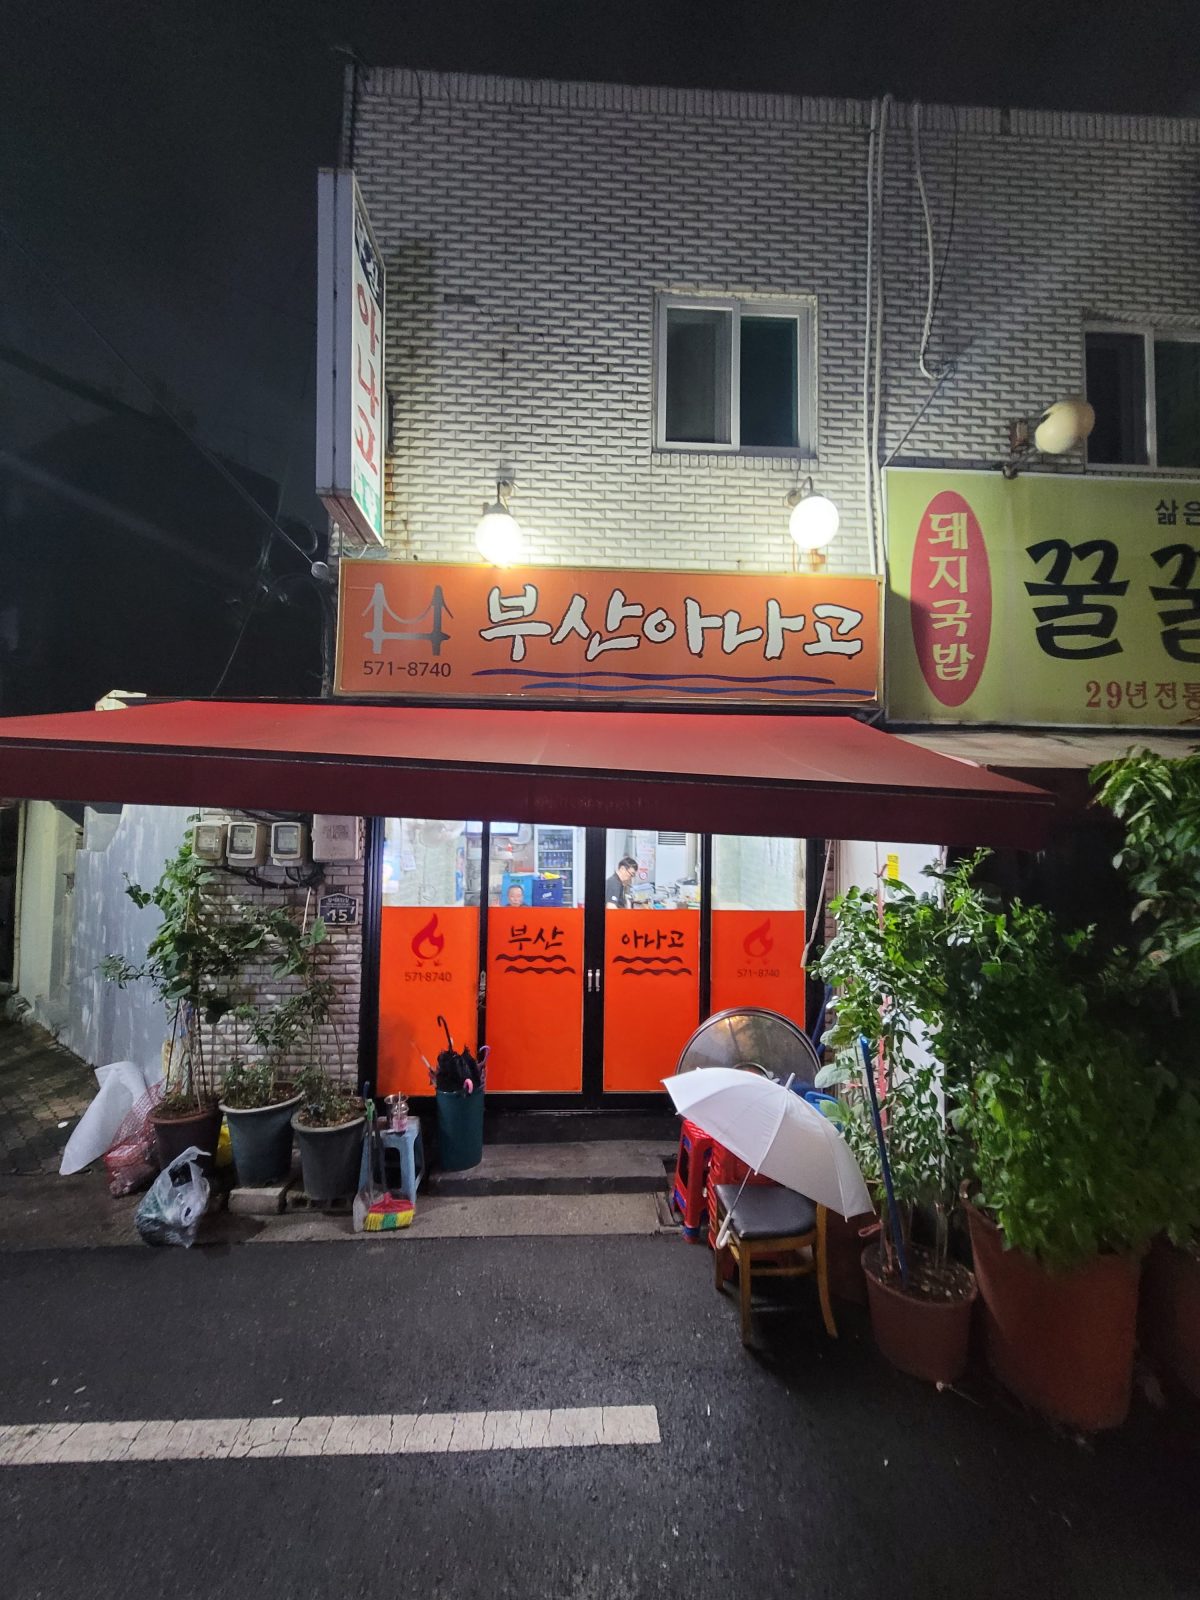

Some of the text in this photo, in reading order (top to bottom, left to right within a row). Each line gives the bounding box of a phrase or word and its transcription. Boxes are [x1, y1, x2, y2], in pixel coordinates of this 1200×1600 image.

[355, 283, 379, 476] 아나고
[928, 511, 976, 682] 돼지국밥
[363, 661, 452, 677] 571-8740
[508, 924, 564, 951] 부산
[621, 929, 686, 951] 아나고
[404, 971, 453, 983] 571-8740
